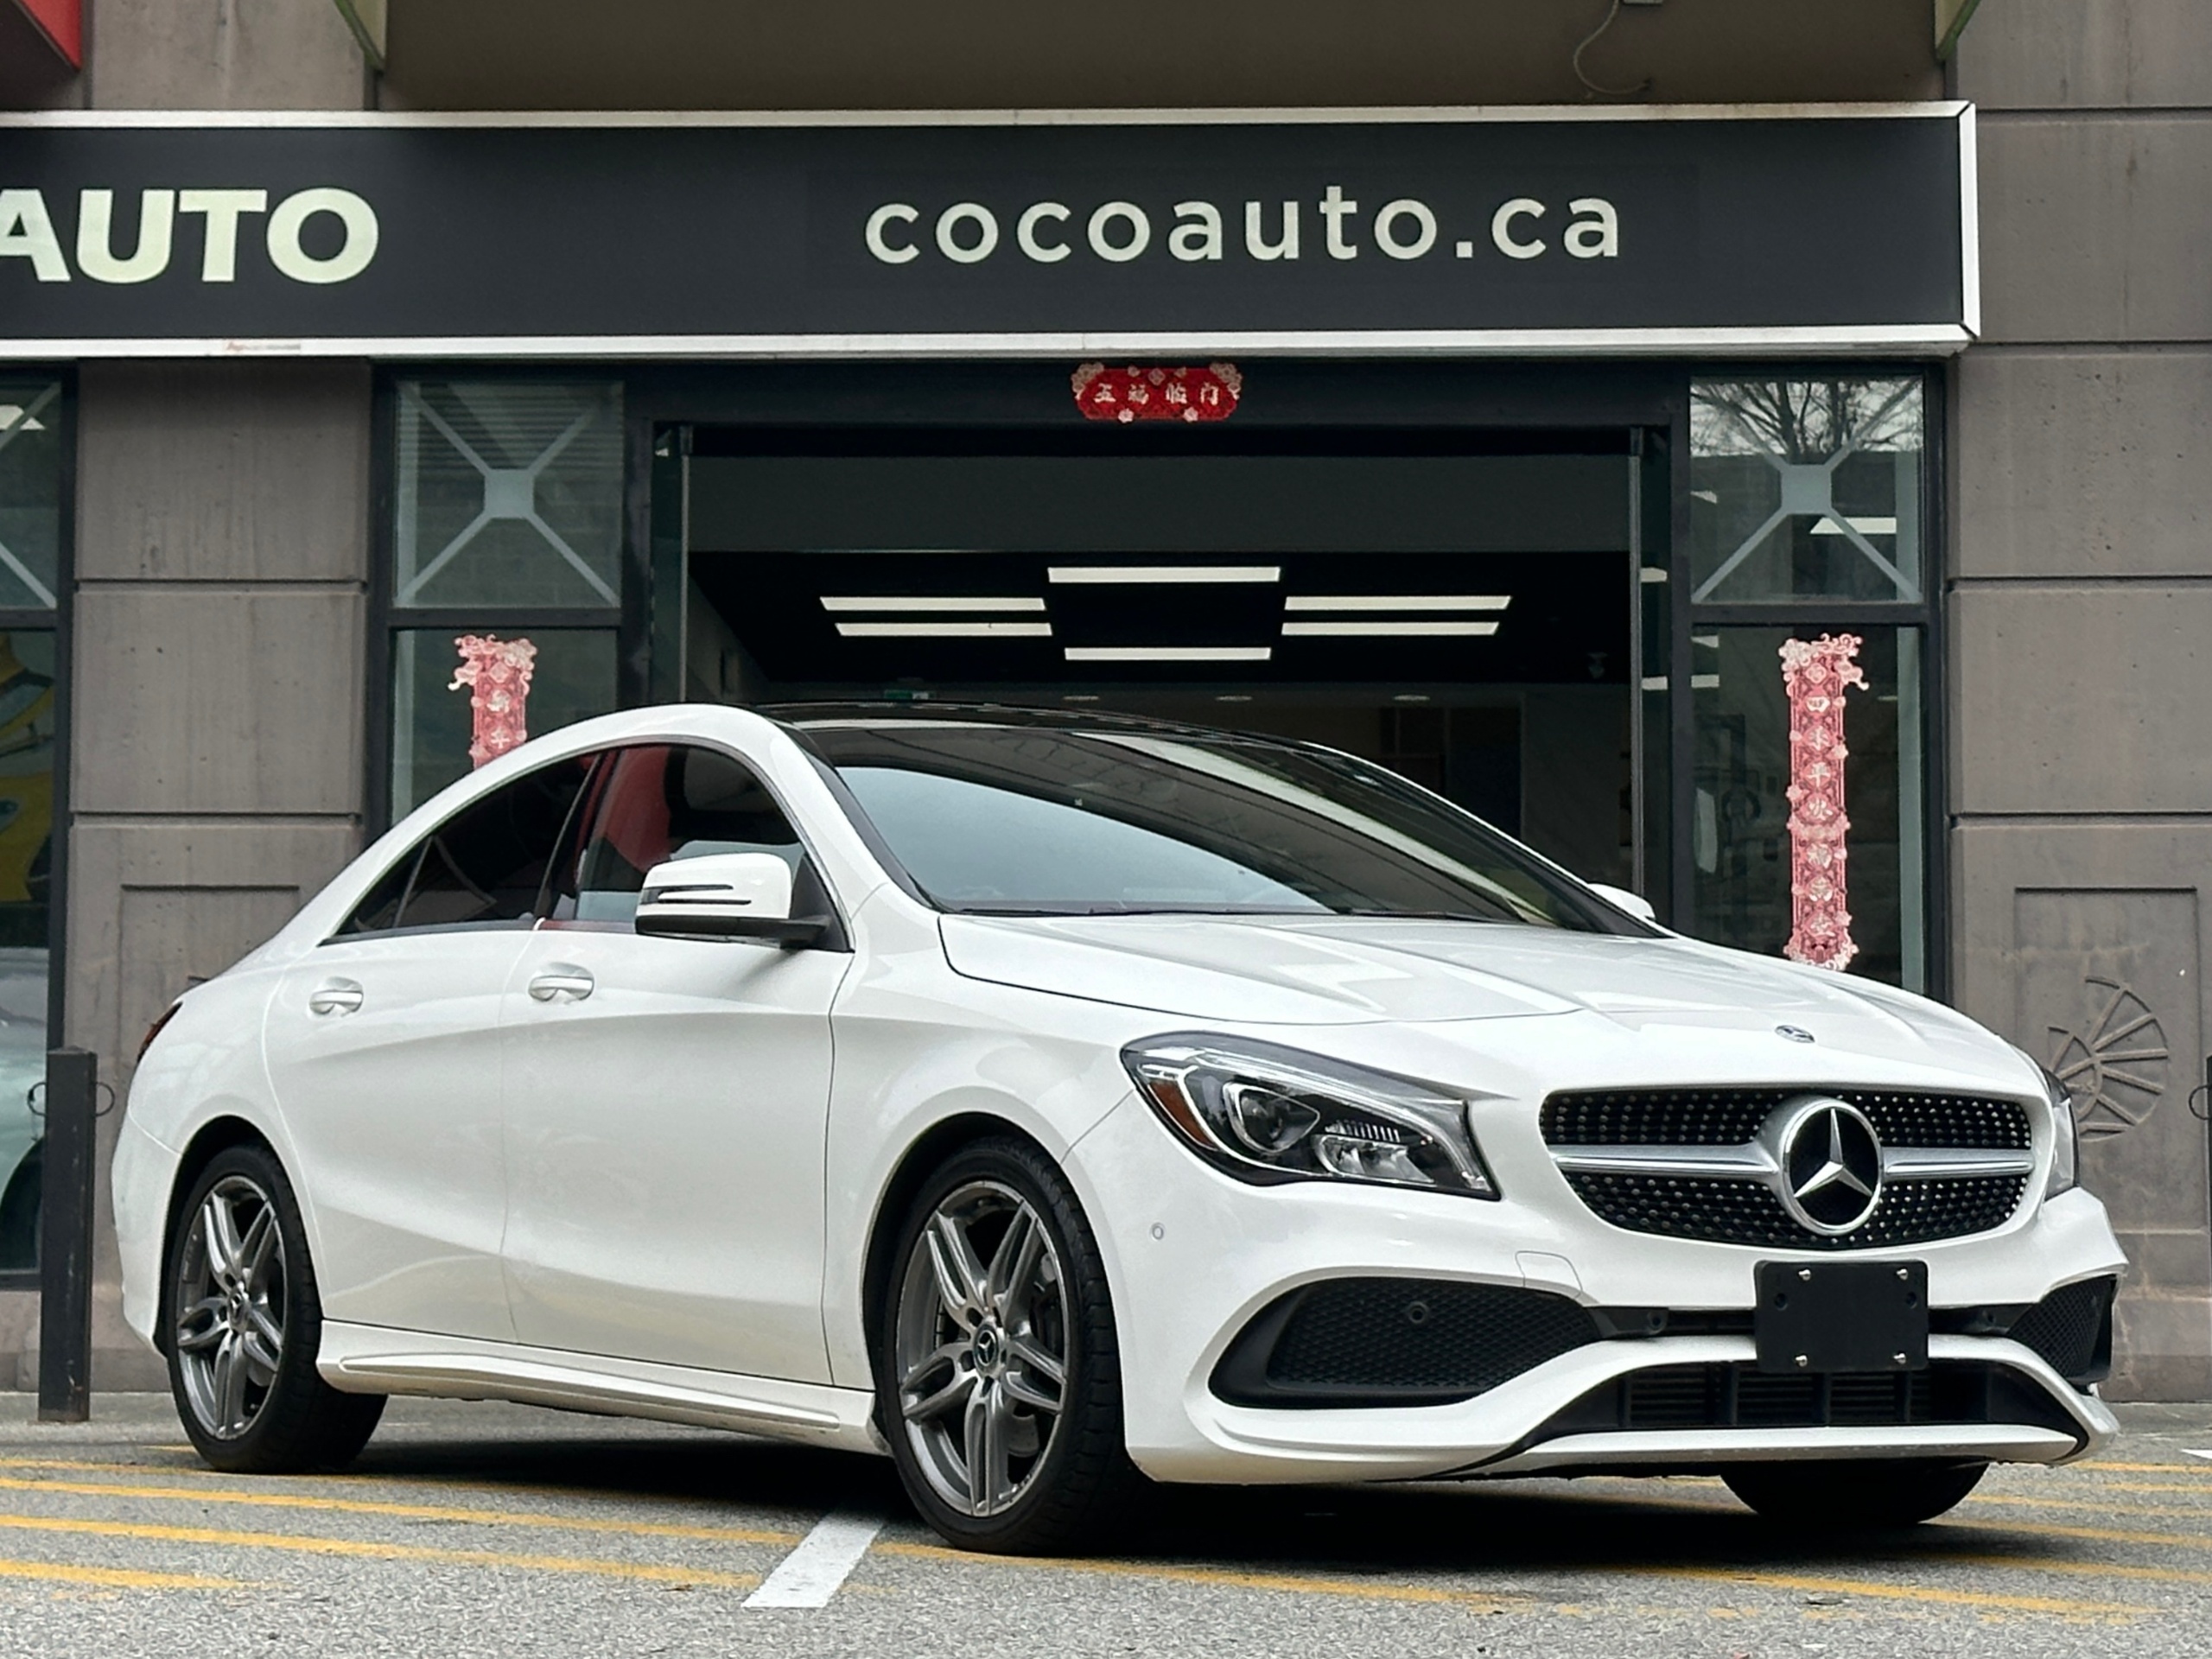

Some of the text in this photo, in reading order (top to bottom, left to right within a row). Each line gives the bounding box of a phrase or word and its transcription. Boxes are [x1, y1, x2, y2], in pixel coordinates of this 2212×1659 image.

[0, 187, 379, 284] AUTO
[865, 186, 1619, 264] cocoauto.ca
[1093, 382, 1219, 405] 五福临门
